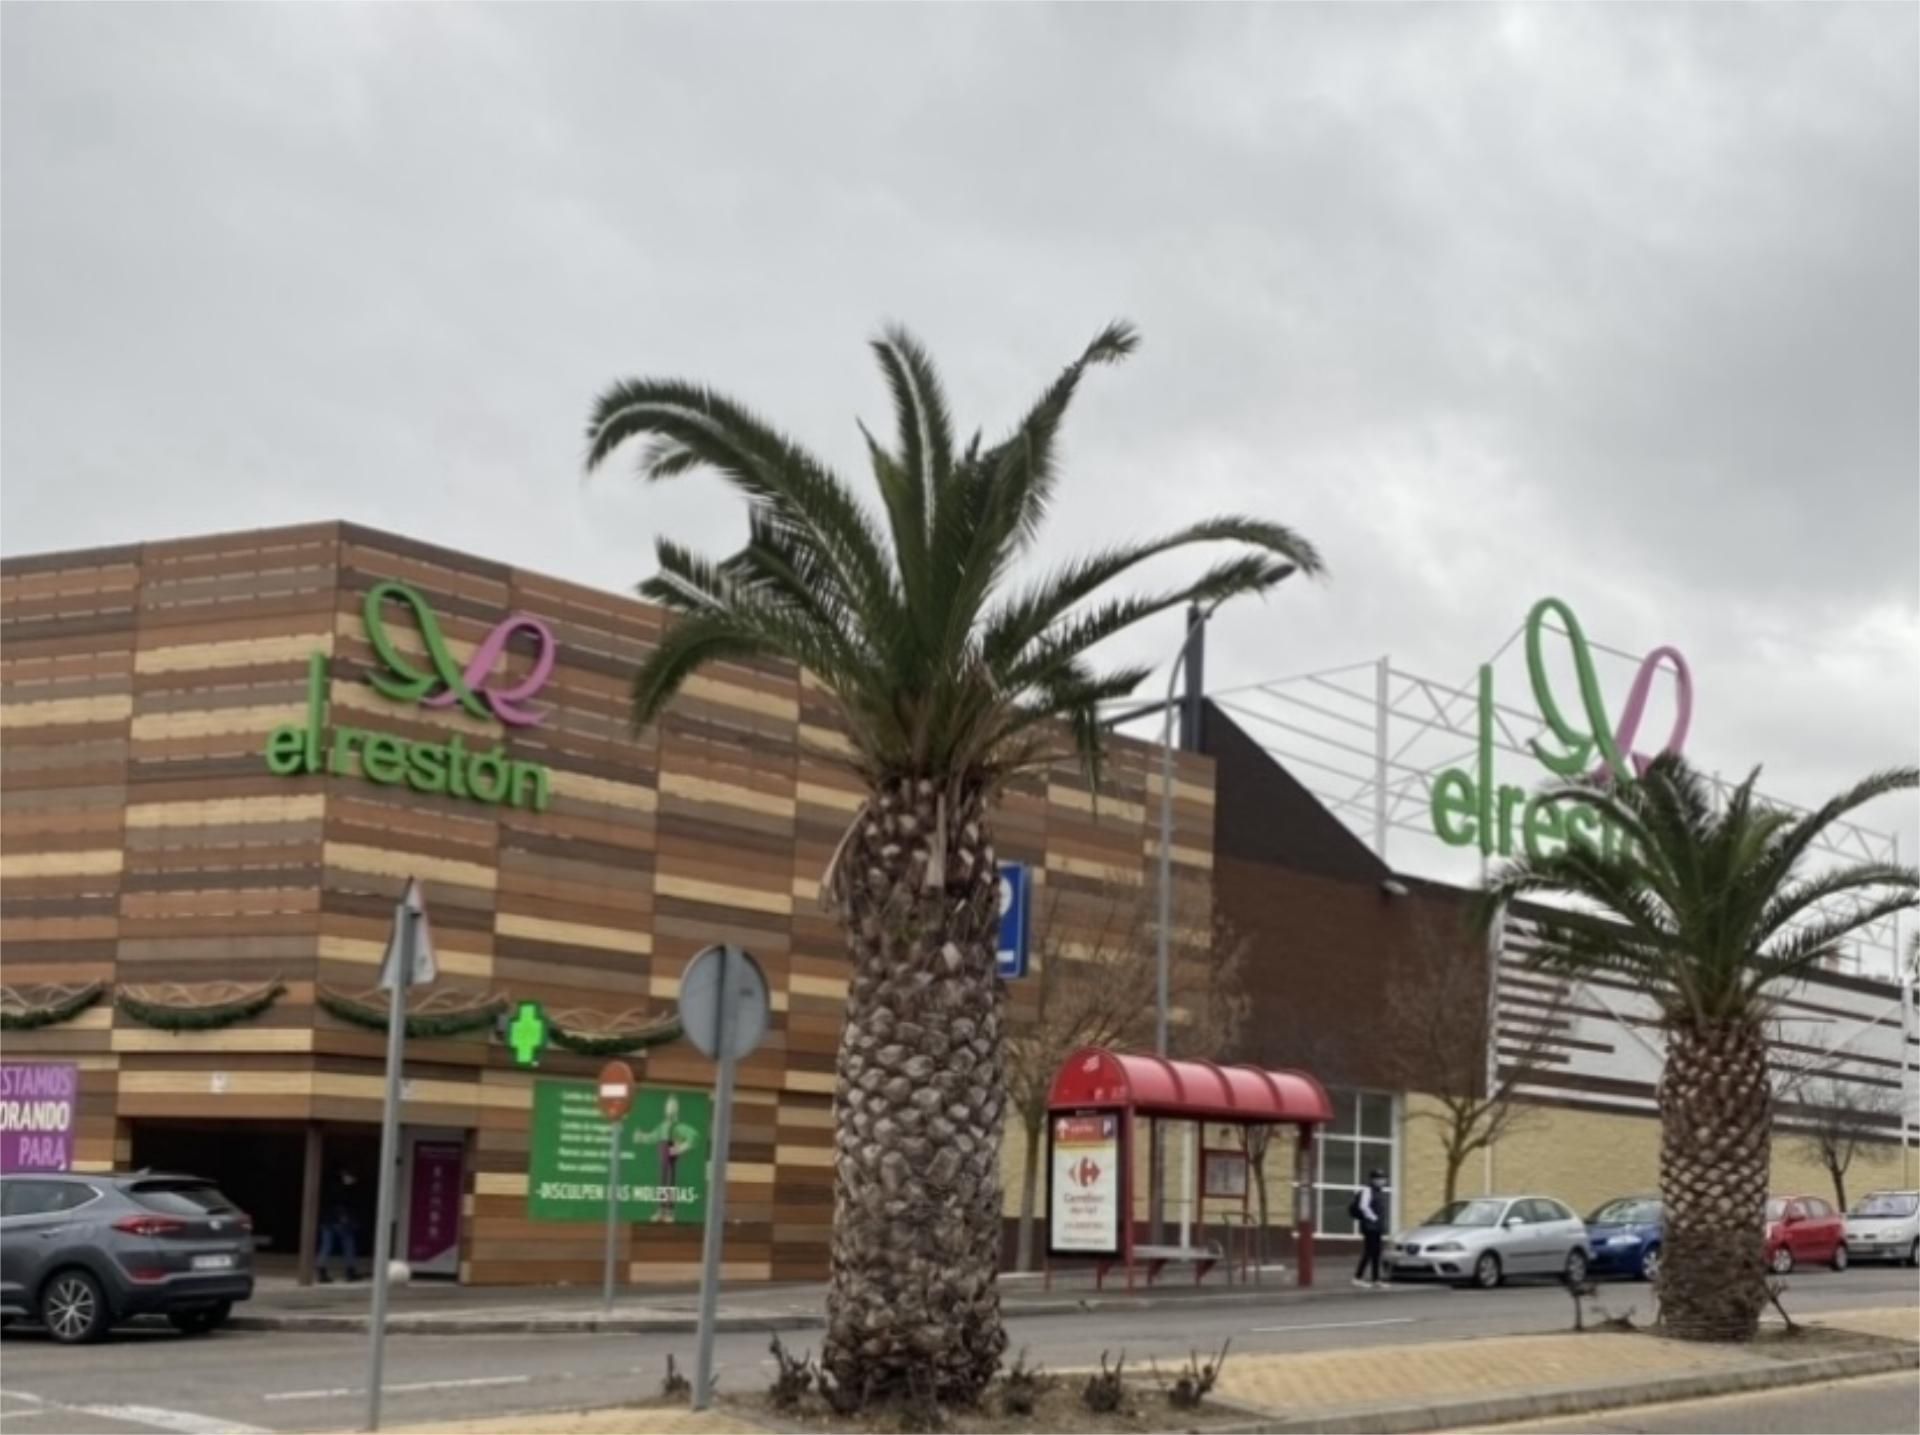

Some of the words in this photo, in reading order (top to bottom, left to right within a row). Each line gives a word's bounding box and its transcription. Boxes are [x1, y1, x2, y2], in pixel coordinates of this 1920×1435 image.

[266, 649, 326, 776] el
[332, 726, 549, 812] restón
[1431, 664, 1493, 857] el
